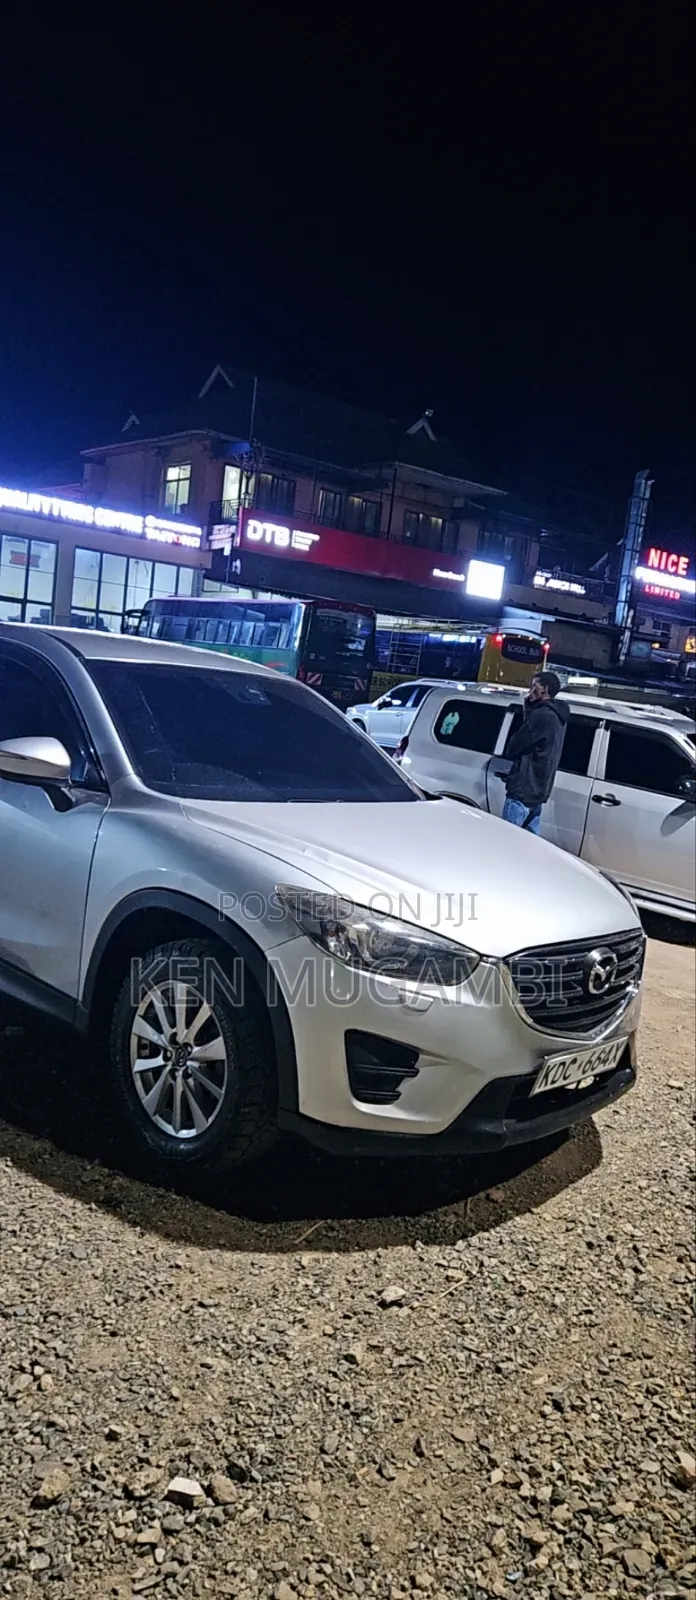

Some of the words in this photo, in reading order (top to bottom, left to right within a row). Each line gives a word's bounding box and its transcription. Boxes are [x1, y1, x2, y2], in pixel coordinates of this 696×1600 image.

[247, 519, 290, 547] DTB
[648, 547, 689, 576] NICE
[644, 584, 681, 599] LIMITED
[507, 644, 528, 655] SCHOOL
[529, 647, 540, 657] BUS
[538, 1057, 577, 1088] KDC
[582, 1041, 625, 1075] 664X
